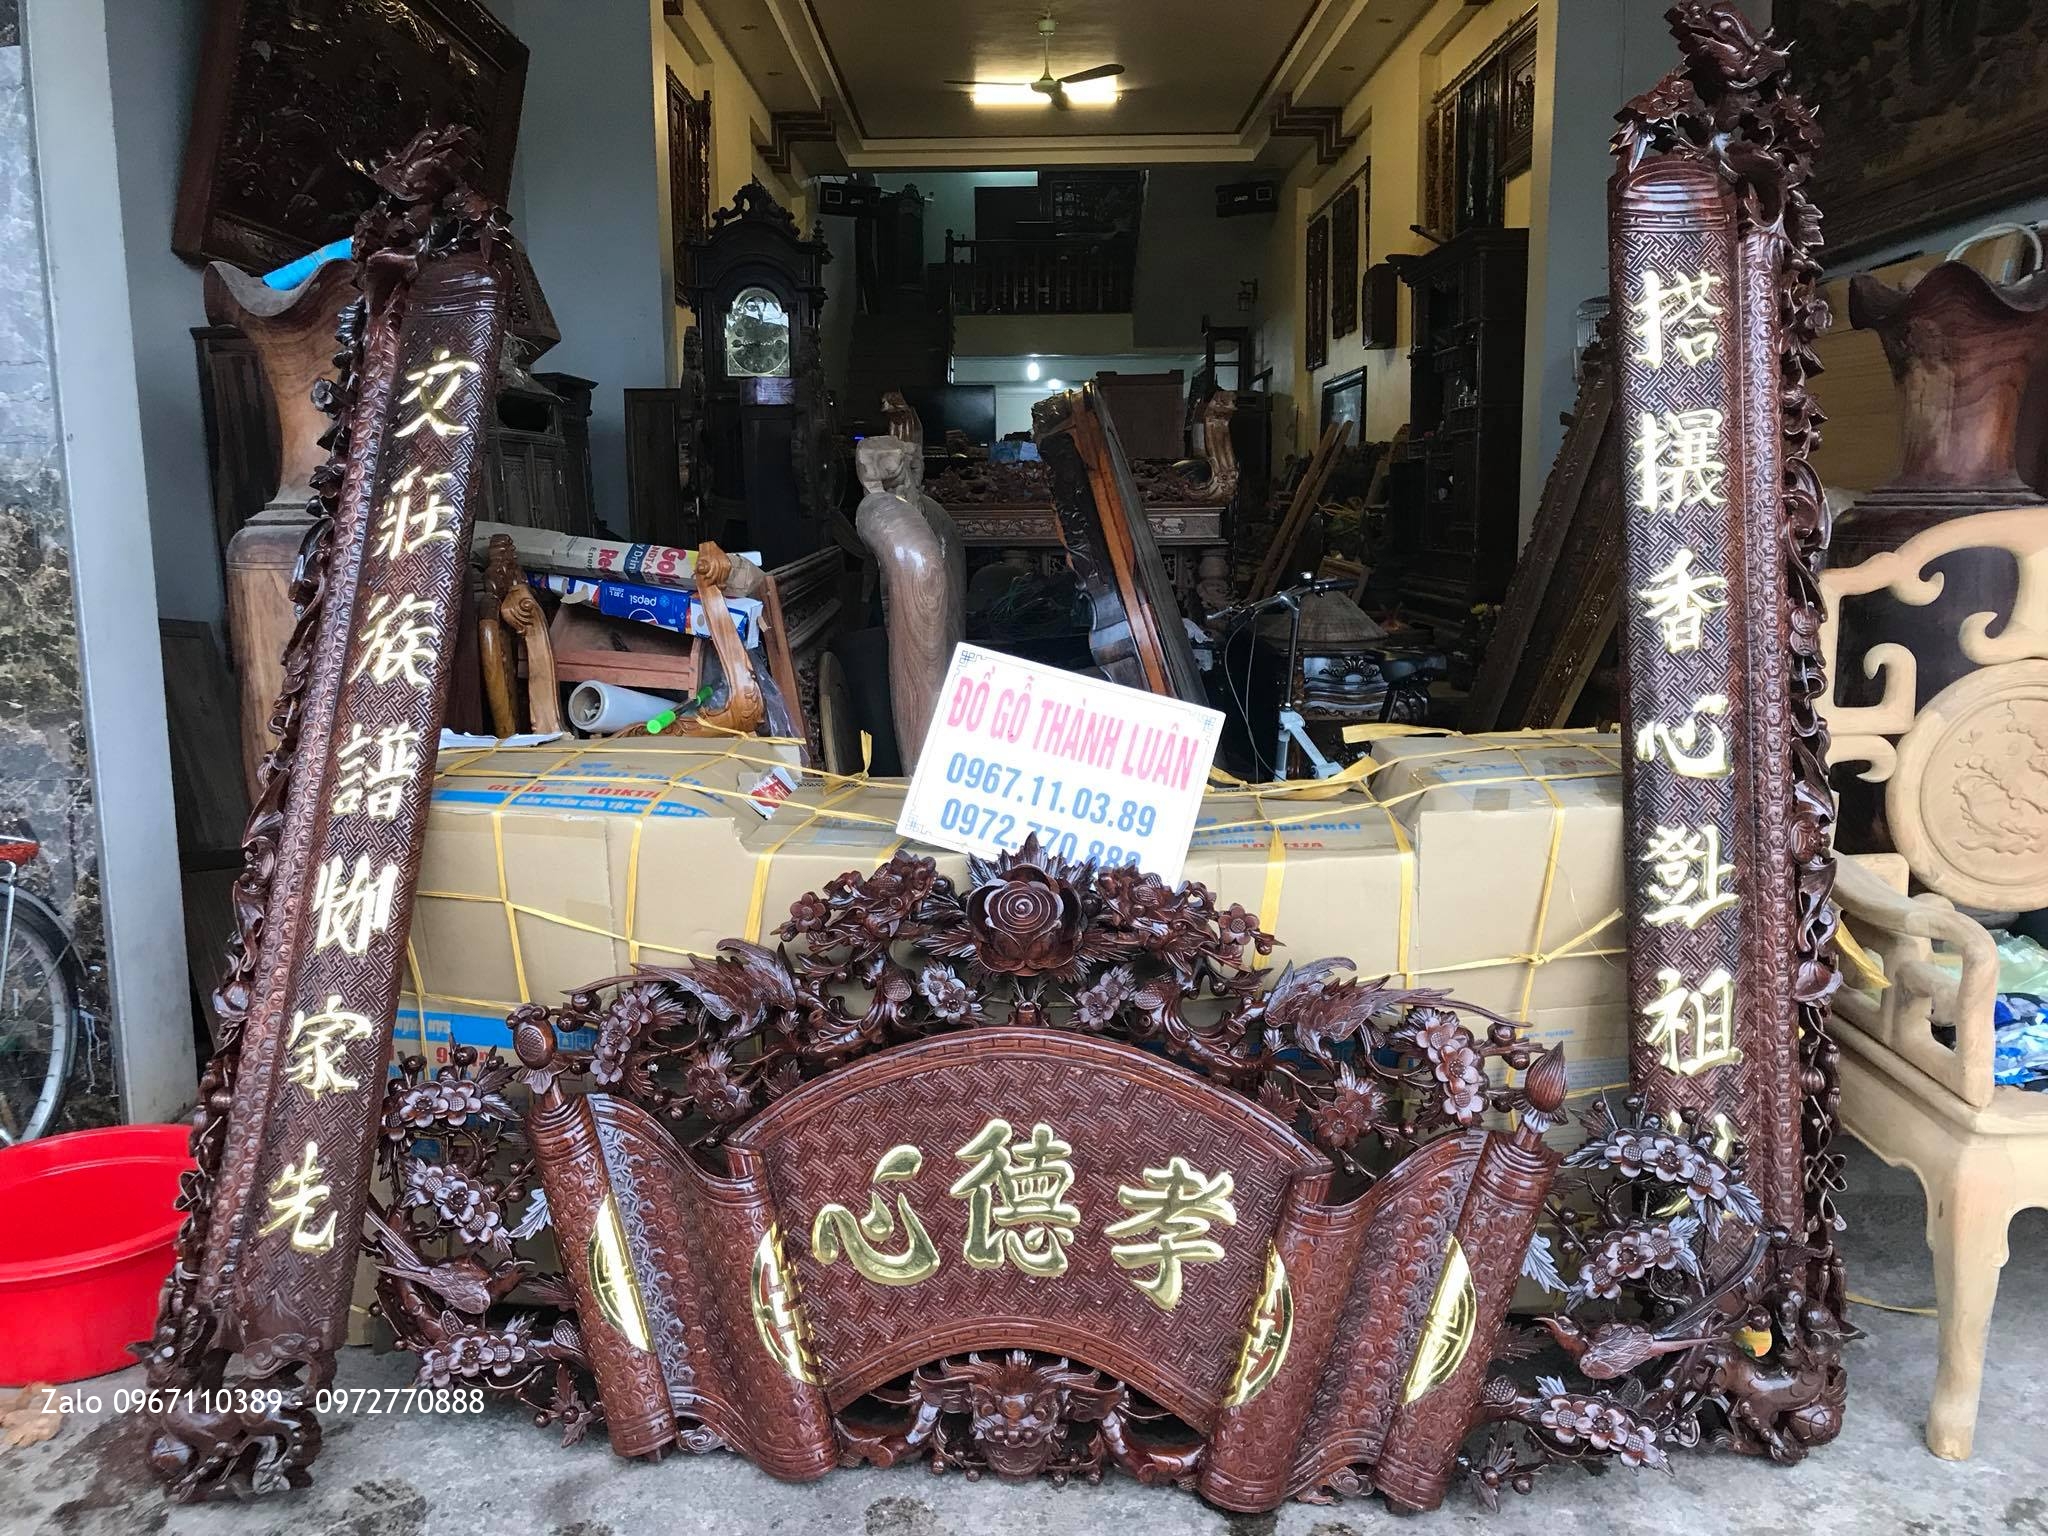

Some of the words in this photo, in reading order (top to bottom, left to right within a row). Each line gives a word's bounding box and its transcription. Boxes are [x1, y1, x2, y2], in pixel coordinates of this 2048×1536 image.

[629, 594, 657, 606] pepsi
[1120, 722, 1200, 791] LUÂN
[945, 752, 1158, 837] 0967.11.03.89
